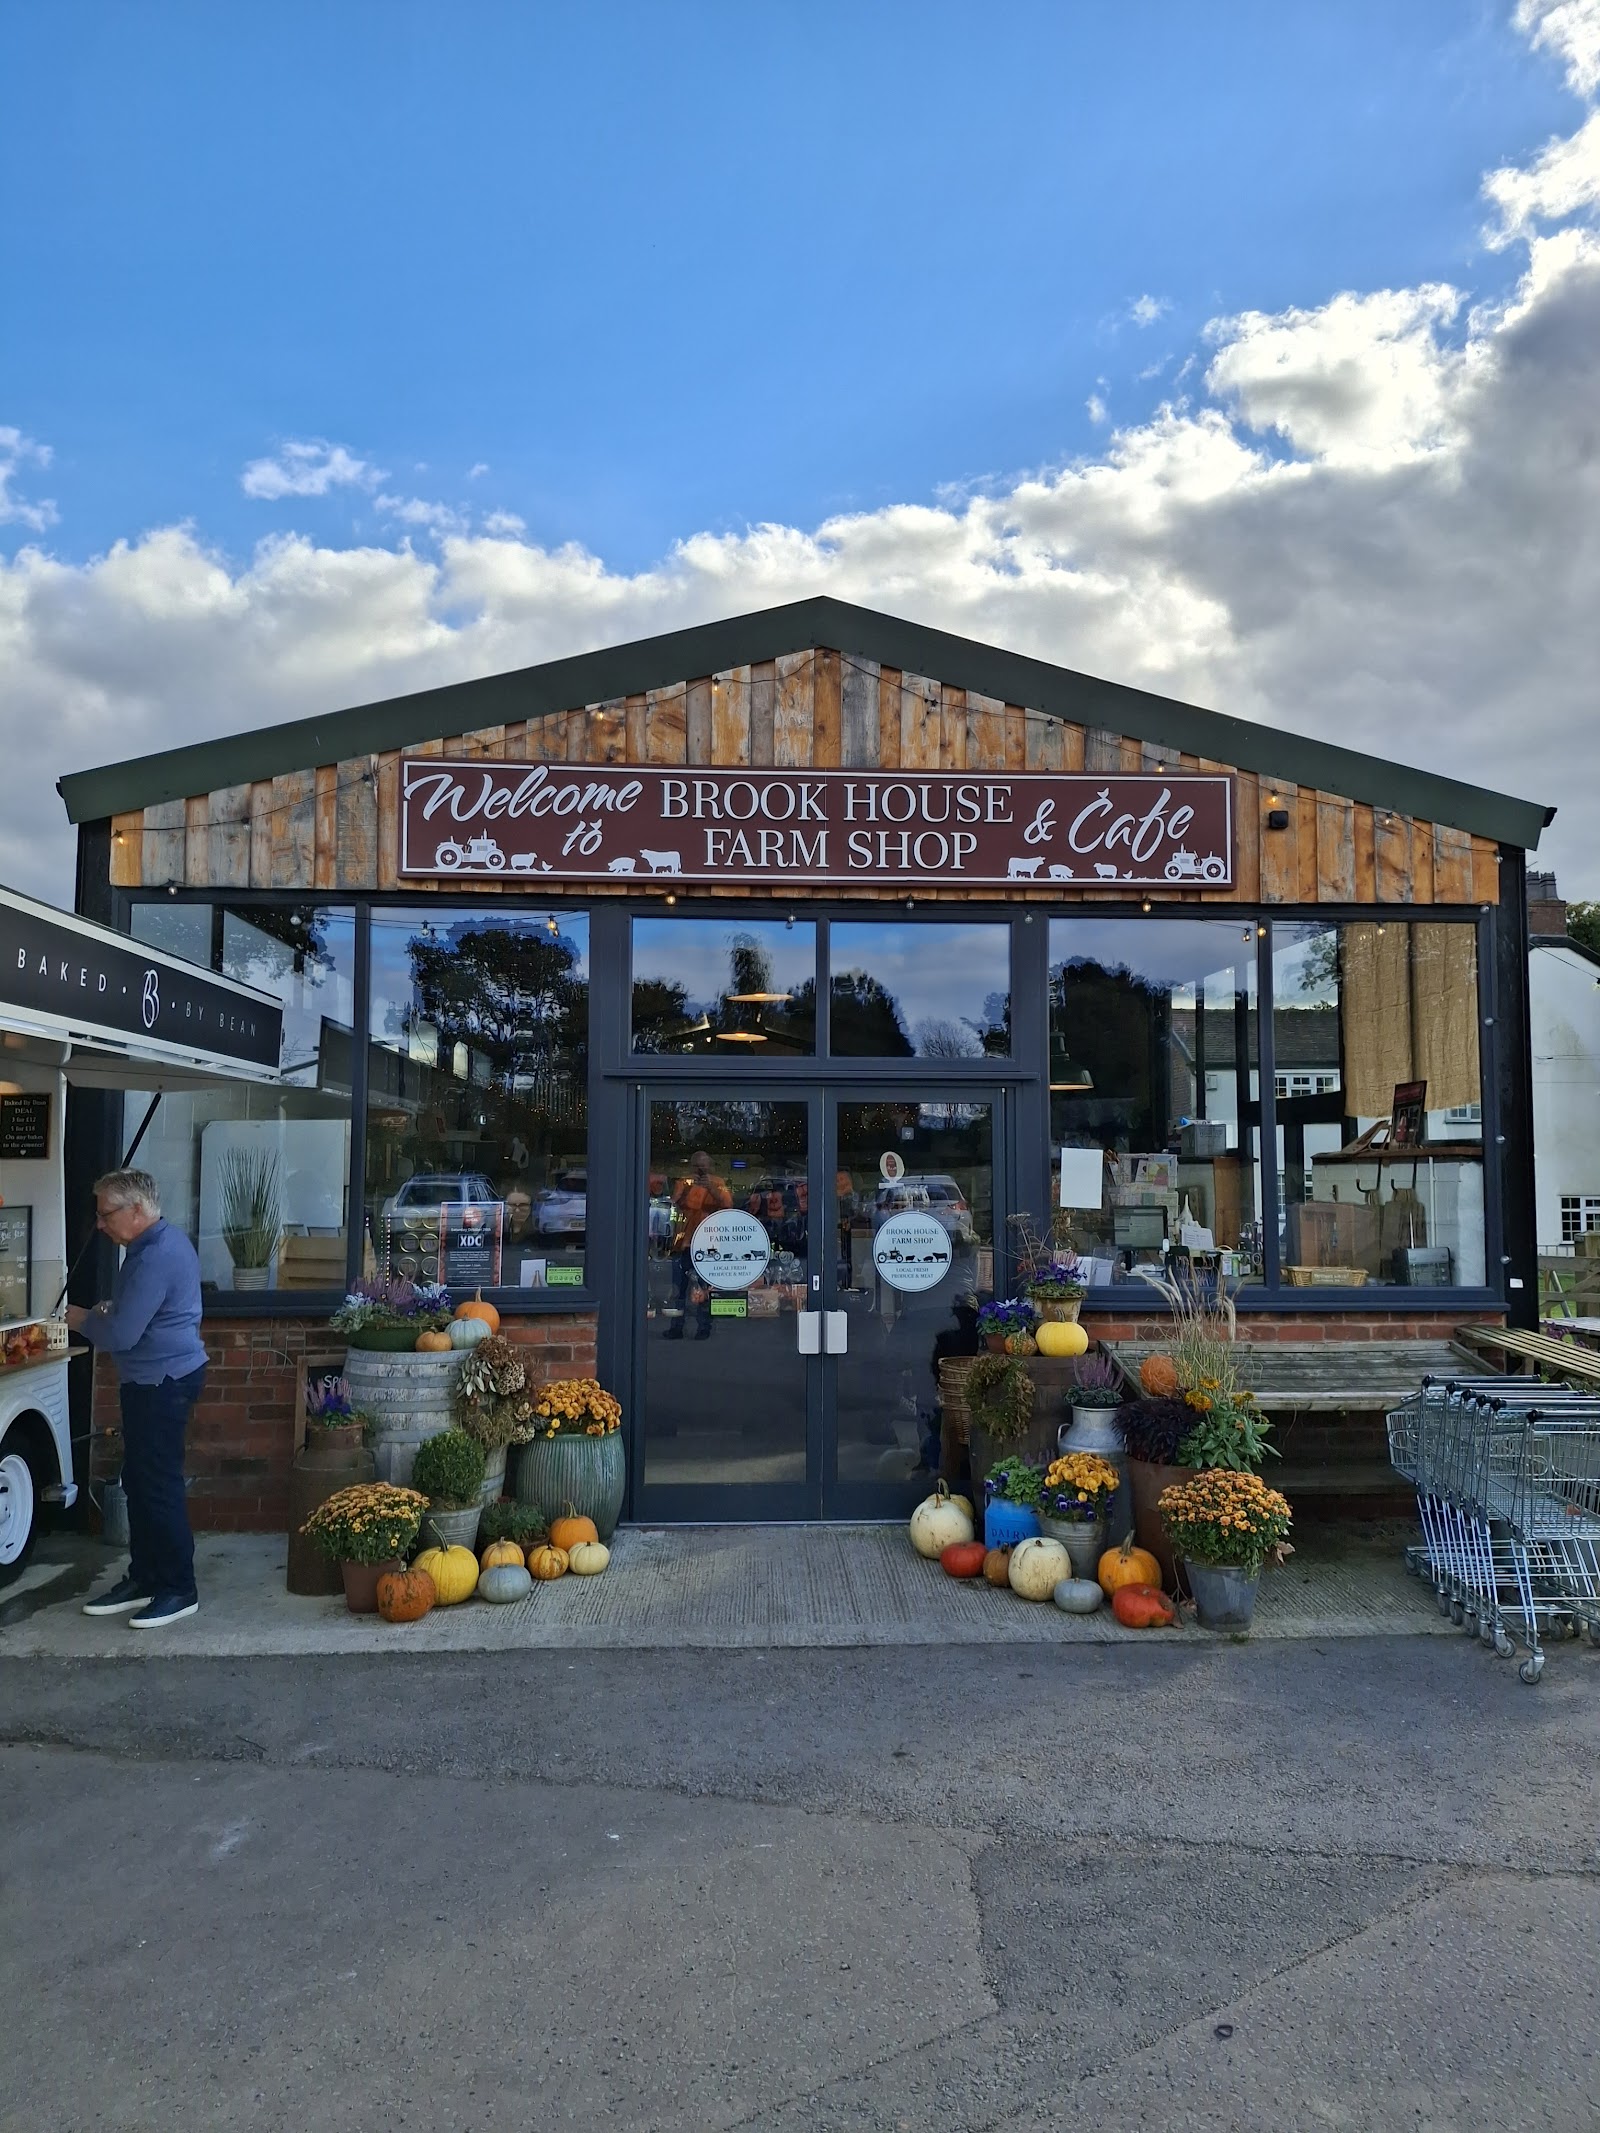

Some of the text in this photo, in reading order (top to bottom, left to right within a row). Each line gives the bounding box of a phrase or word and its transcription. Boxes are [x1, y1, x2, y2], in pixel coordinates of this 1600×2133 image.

[404, 765, 643, 822] Welcome
[660, 779, 1014, 824] BROOK HOUSE
[561, 819, 603, 857] to
[1023, 798, 1059, 845] &
[703, 828, 978, 870] FARM SHOP
[17, 947, 107, 992] BAKED
[185, 1001, 204, 1022] BY
[218, 1012, 257, 1037] BEAN
[460, 1235, 482, 1247] XDC
[703, 1225, 758, 1233] BROOK HOUSE
[991, 1528, 1029, 1540] DAIRY
